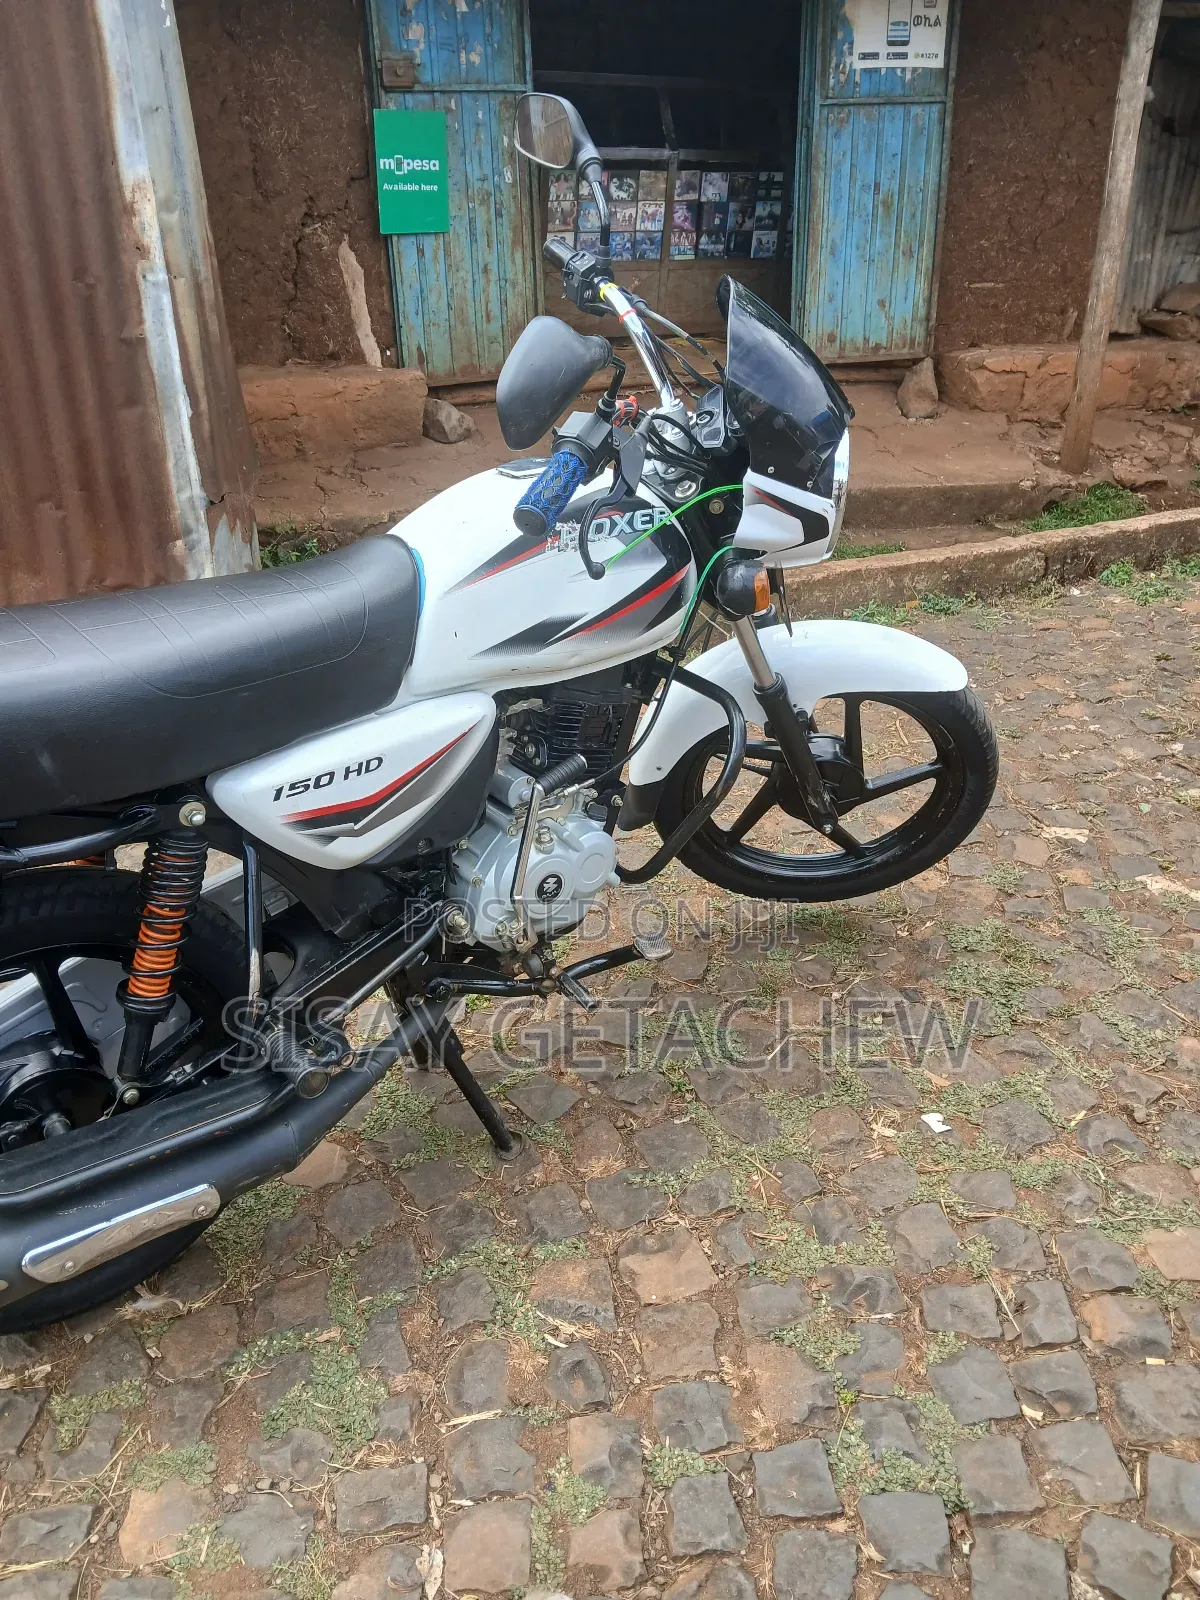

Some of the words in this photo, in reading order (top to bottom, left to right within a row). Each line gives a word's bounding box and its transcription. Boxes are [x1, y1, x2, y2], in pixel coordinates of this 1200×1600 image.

[383, 182, 420, 191] Available
[421, 183, 438, 191] here
[273, 770, 336, 803] 150
[344, 756, 384, 781] HD
